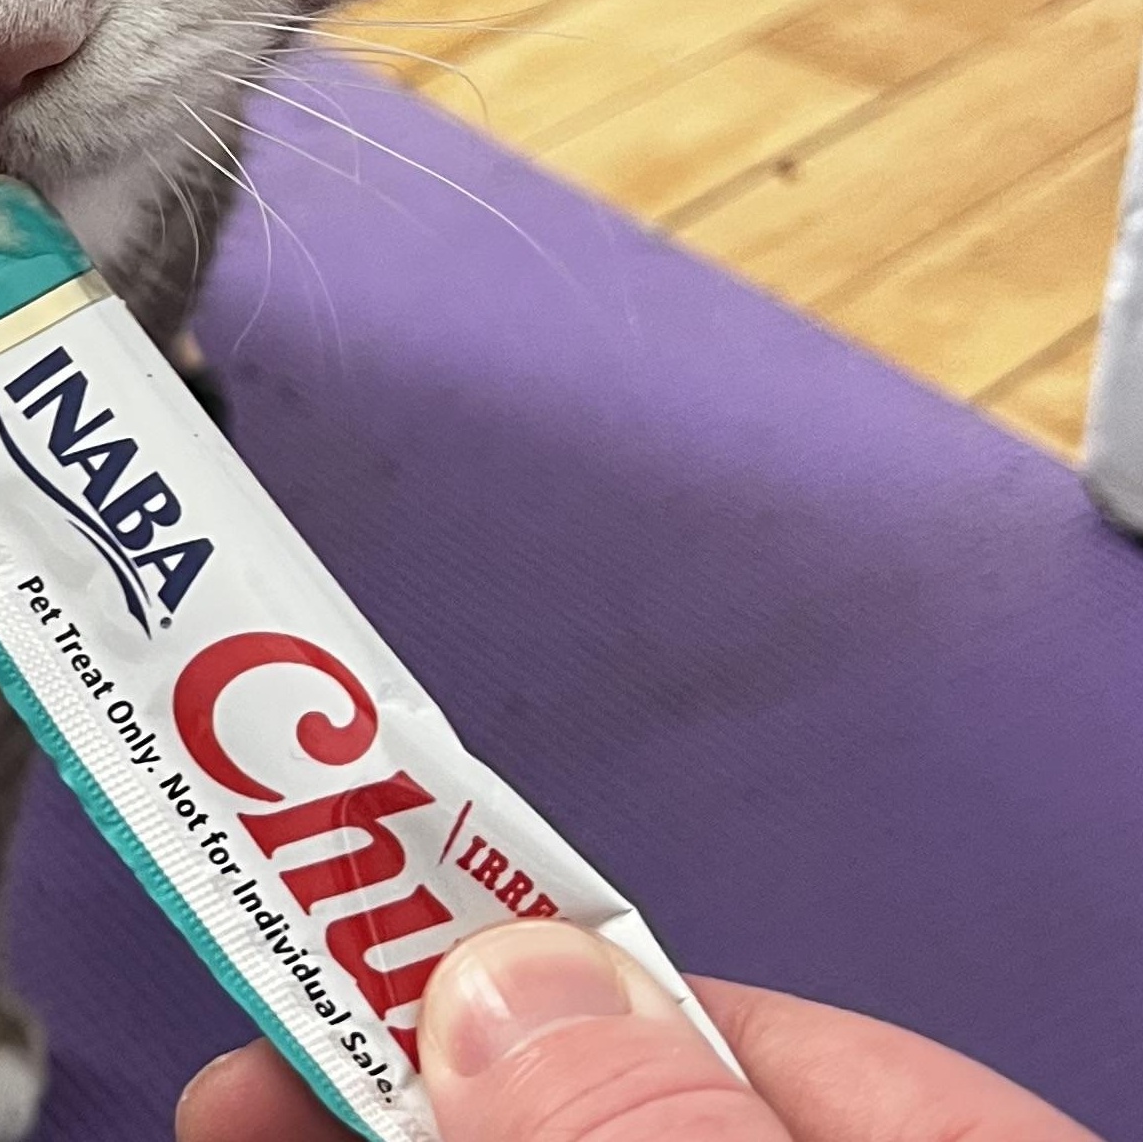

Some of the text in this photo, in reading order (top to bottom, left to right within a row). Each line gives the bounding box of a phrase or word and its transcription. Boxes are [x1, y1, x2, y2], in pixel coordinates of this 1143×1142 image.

[3, 345, 215, 614] INABA
[17, 575, 394, 1104] Pet Treat Only. Not for Individual Sale.
[172, 631, 458, 1075] Chu
[455, 835, 570, 921] IRRE
